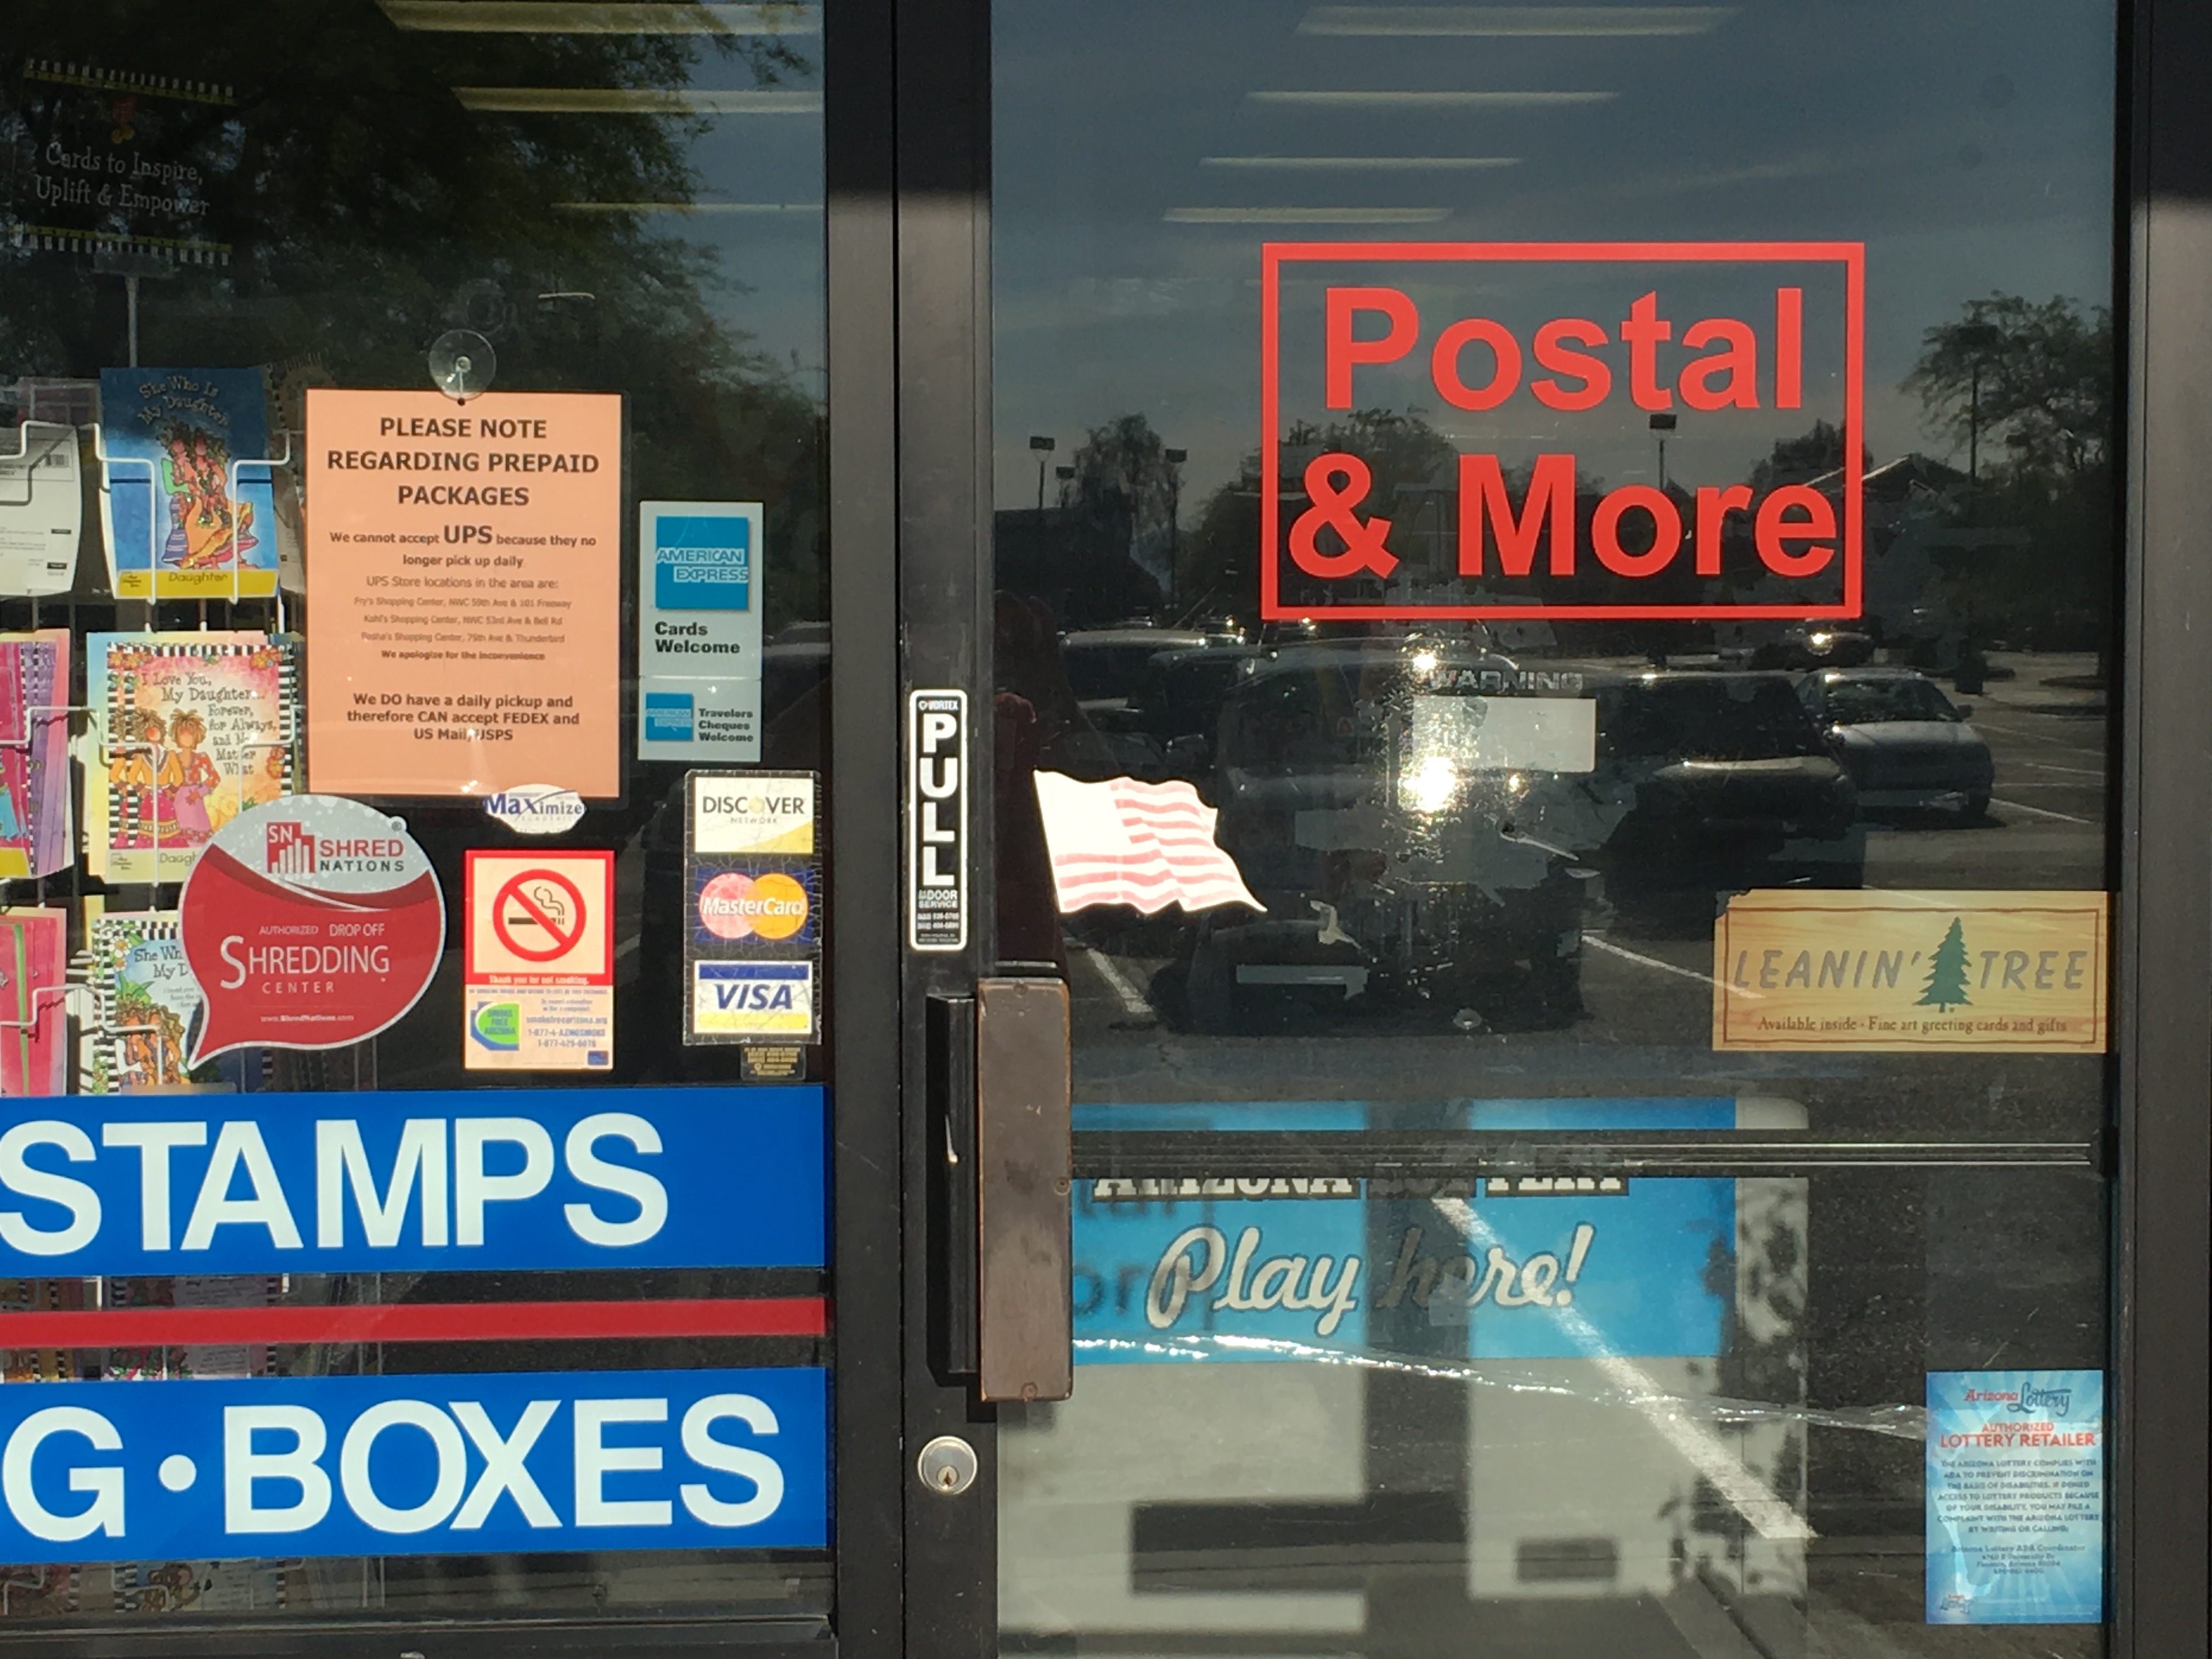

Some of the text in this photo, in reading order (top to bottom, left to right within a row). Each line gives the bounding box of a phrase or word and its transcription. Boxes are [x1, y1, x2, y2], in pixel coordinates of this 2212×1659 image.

[46, 142, 204, 184] Cards to Inspire,
[35, 174, 210, 217] Uplift & Empower
[1325, 287, 1803, 411] Postal
[138, 375, 219, 399] She Who Is
[137, 395, 230, 426] My Daughter
[381, 417, 546, 439] PLEASE NOTE
[328, 450, 599, 473] REGARDING PREPAID
[398, 484, 529, 507] PACKAGES
[1288, 453, 1837, 579] & More
[329, 524, 596, 548] We cannot accept UPS because they no
[403, 554, 524, 569] longer pick up daily
[657, 549, 743, 563] AMERICAN
[168, 572, 229, 585] Daughter
[366, 575, 390, 587] UPS
[391, 575, 421, 588] Store
[424, 576, 473, 588] locations
[475, 578, 486, 588] in
[488, 577, 507, 589] the
[510, 579, 534, 589] area
[675, 568, 749, 581] EXPRESS
[654, 621, 708, 636] Cards
[654, 639, 741, 654] Welcome
[381, 650, 397, 658] We
[398, 650, 443, 661] apologize
[445, 651, 459, 659] for
[461, 651, 477, 659] the
[153, 673, 182, 686] Love
[1430, 669, 1584, 691] WARNING
[161, 687, 184, 704] My
[353, 693, 573, 710] We DO have a daily pickup and
[347, 709, 580, 726] therefore CAN accept FEDEX and
[698, 708, 754, 718] Travelers
[414, 727, 433, 740] US
[698, 720, 751, 732] Cheques
[698, 732, 754, 743] Welcome
[216, 748, 256, 761] Mater
[702, 795, 805, 815] DISCOVER
[919, 713, 958, 887] PULL
[730, 816, 778, 825] NETWORK
[268, 825, 293, 844] SN
[319, 839, 404, 857] SHRED
[320, 859, 405, 872] NATIONS
[927, 889, 958, 900] DOOR
[701, 896, 803, 917] MasterCard
[259, 923, 386, 936] AUTHORIZED DROP OFF
[134, 947, 158, 963] She
[220, 935, 390, 989] SHREDDING
[153, 963, 176, 980] My
[1734, 949, 2088, 991] LEANIN' TREE
[262, 981, 335, 994] CENTER
[715, 983, 793, 1011] VISA
[1757, 1015, 2067, 1036] Available inside Fine art greeting cards and gifts
[0, 1112, 669, 1256] STAMPS
[1147, 1225, 1360, 1336] Play
[1963, 1381, 2072, 1418] Arizona Lottery
[1982, 1422, 2055, 1432] AUTHORIZED
[1939, 1432, 2096, 1448] LOTTERY RETAILER
[223, 1393, 785, 1535] BOXES
